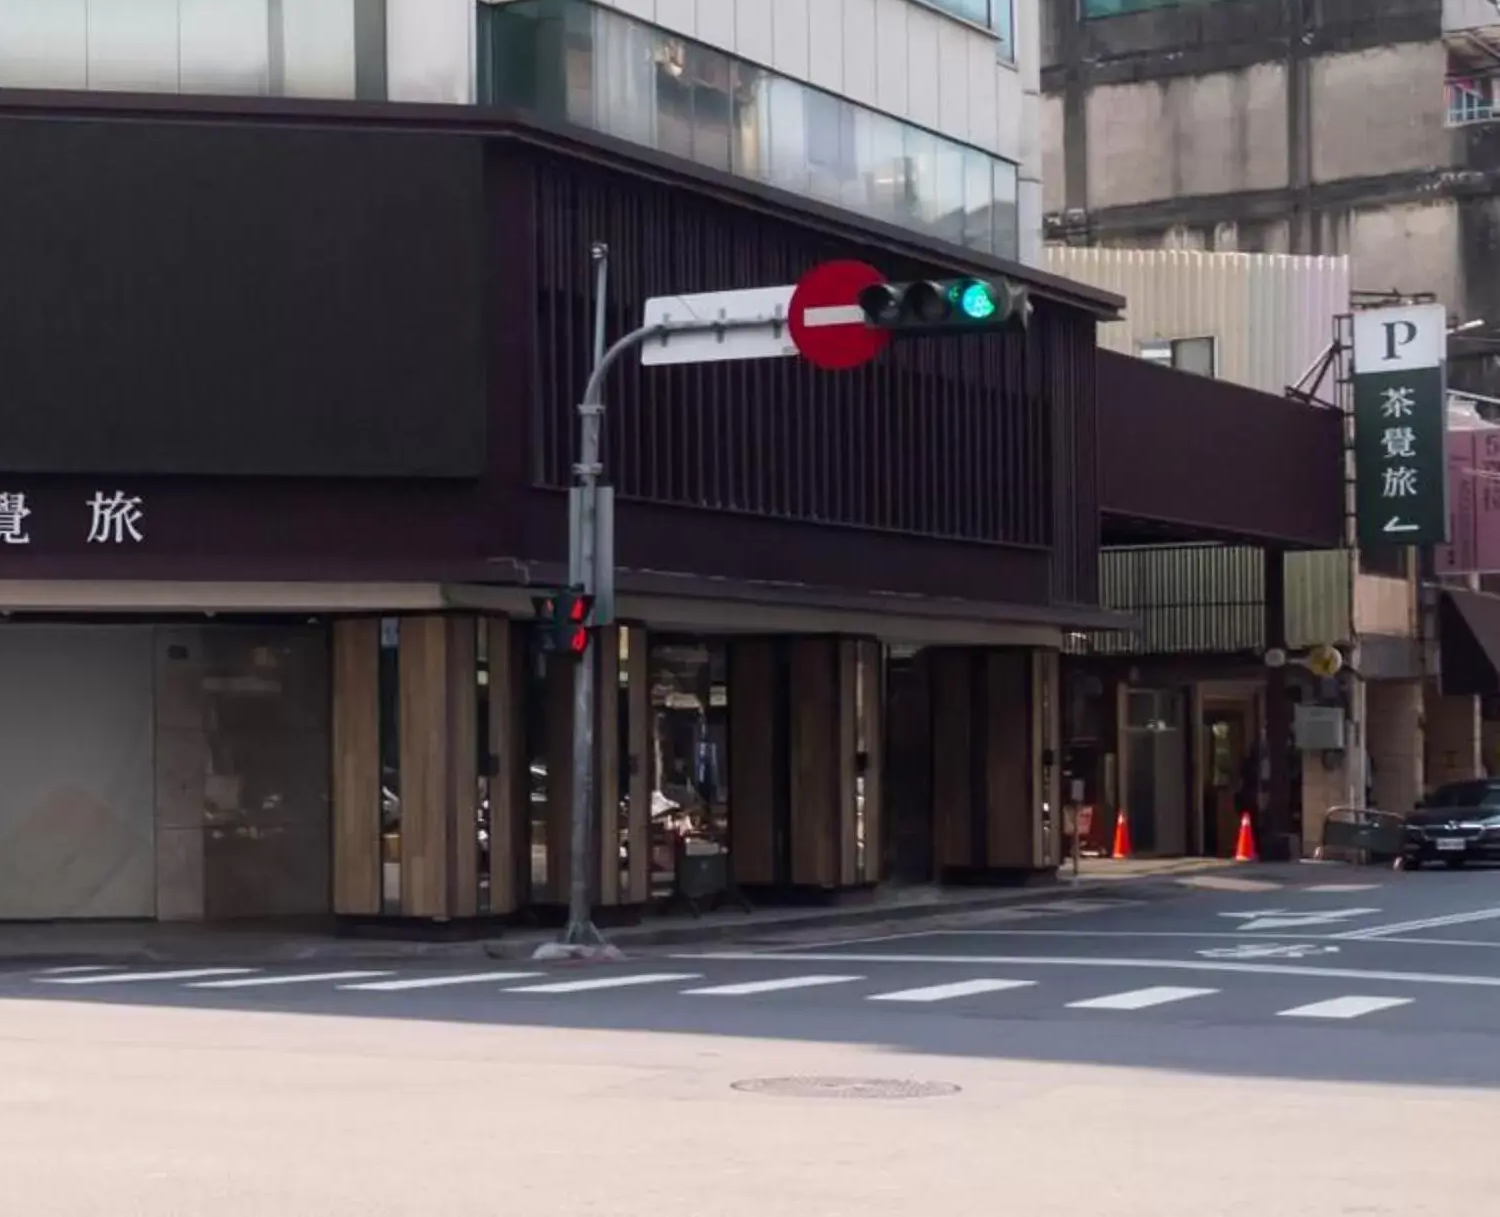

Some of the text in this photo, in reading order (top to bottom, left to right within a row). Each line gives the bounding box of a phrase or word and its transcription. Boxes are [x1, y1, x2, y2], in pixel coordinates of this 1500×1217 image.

[1381, 319, 1418, 361] P
[1379, 386, 1418, 498] 茶覺旅
